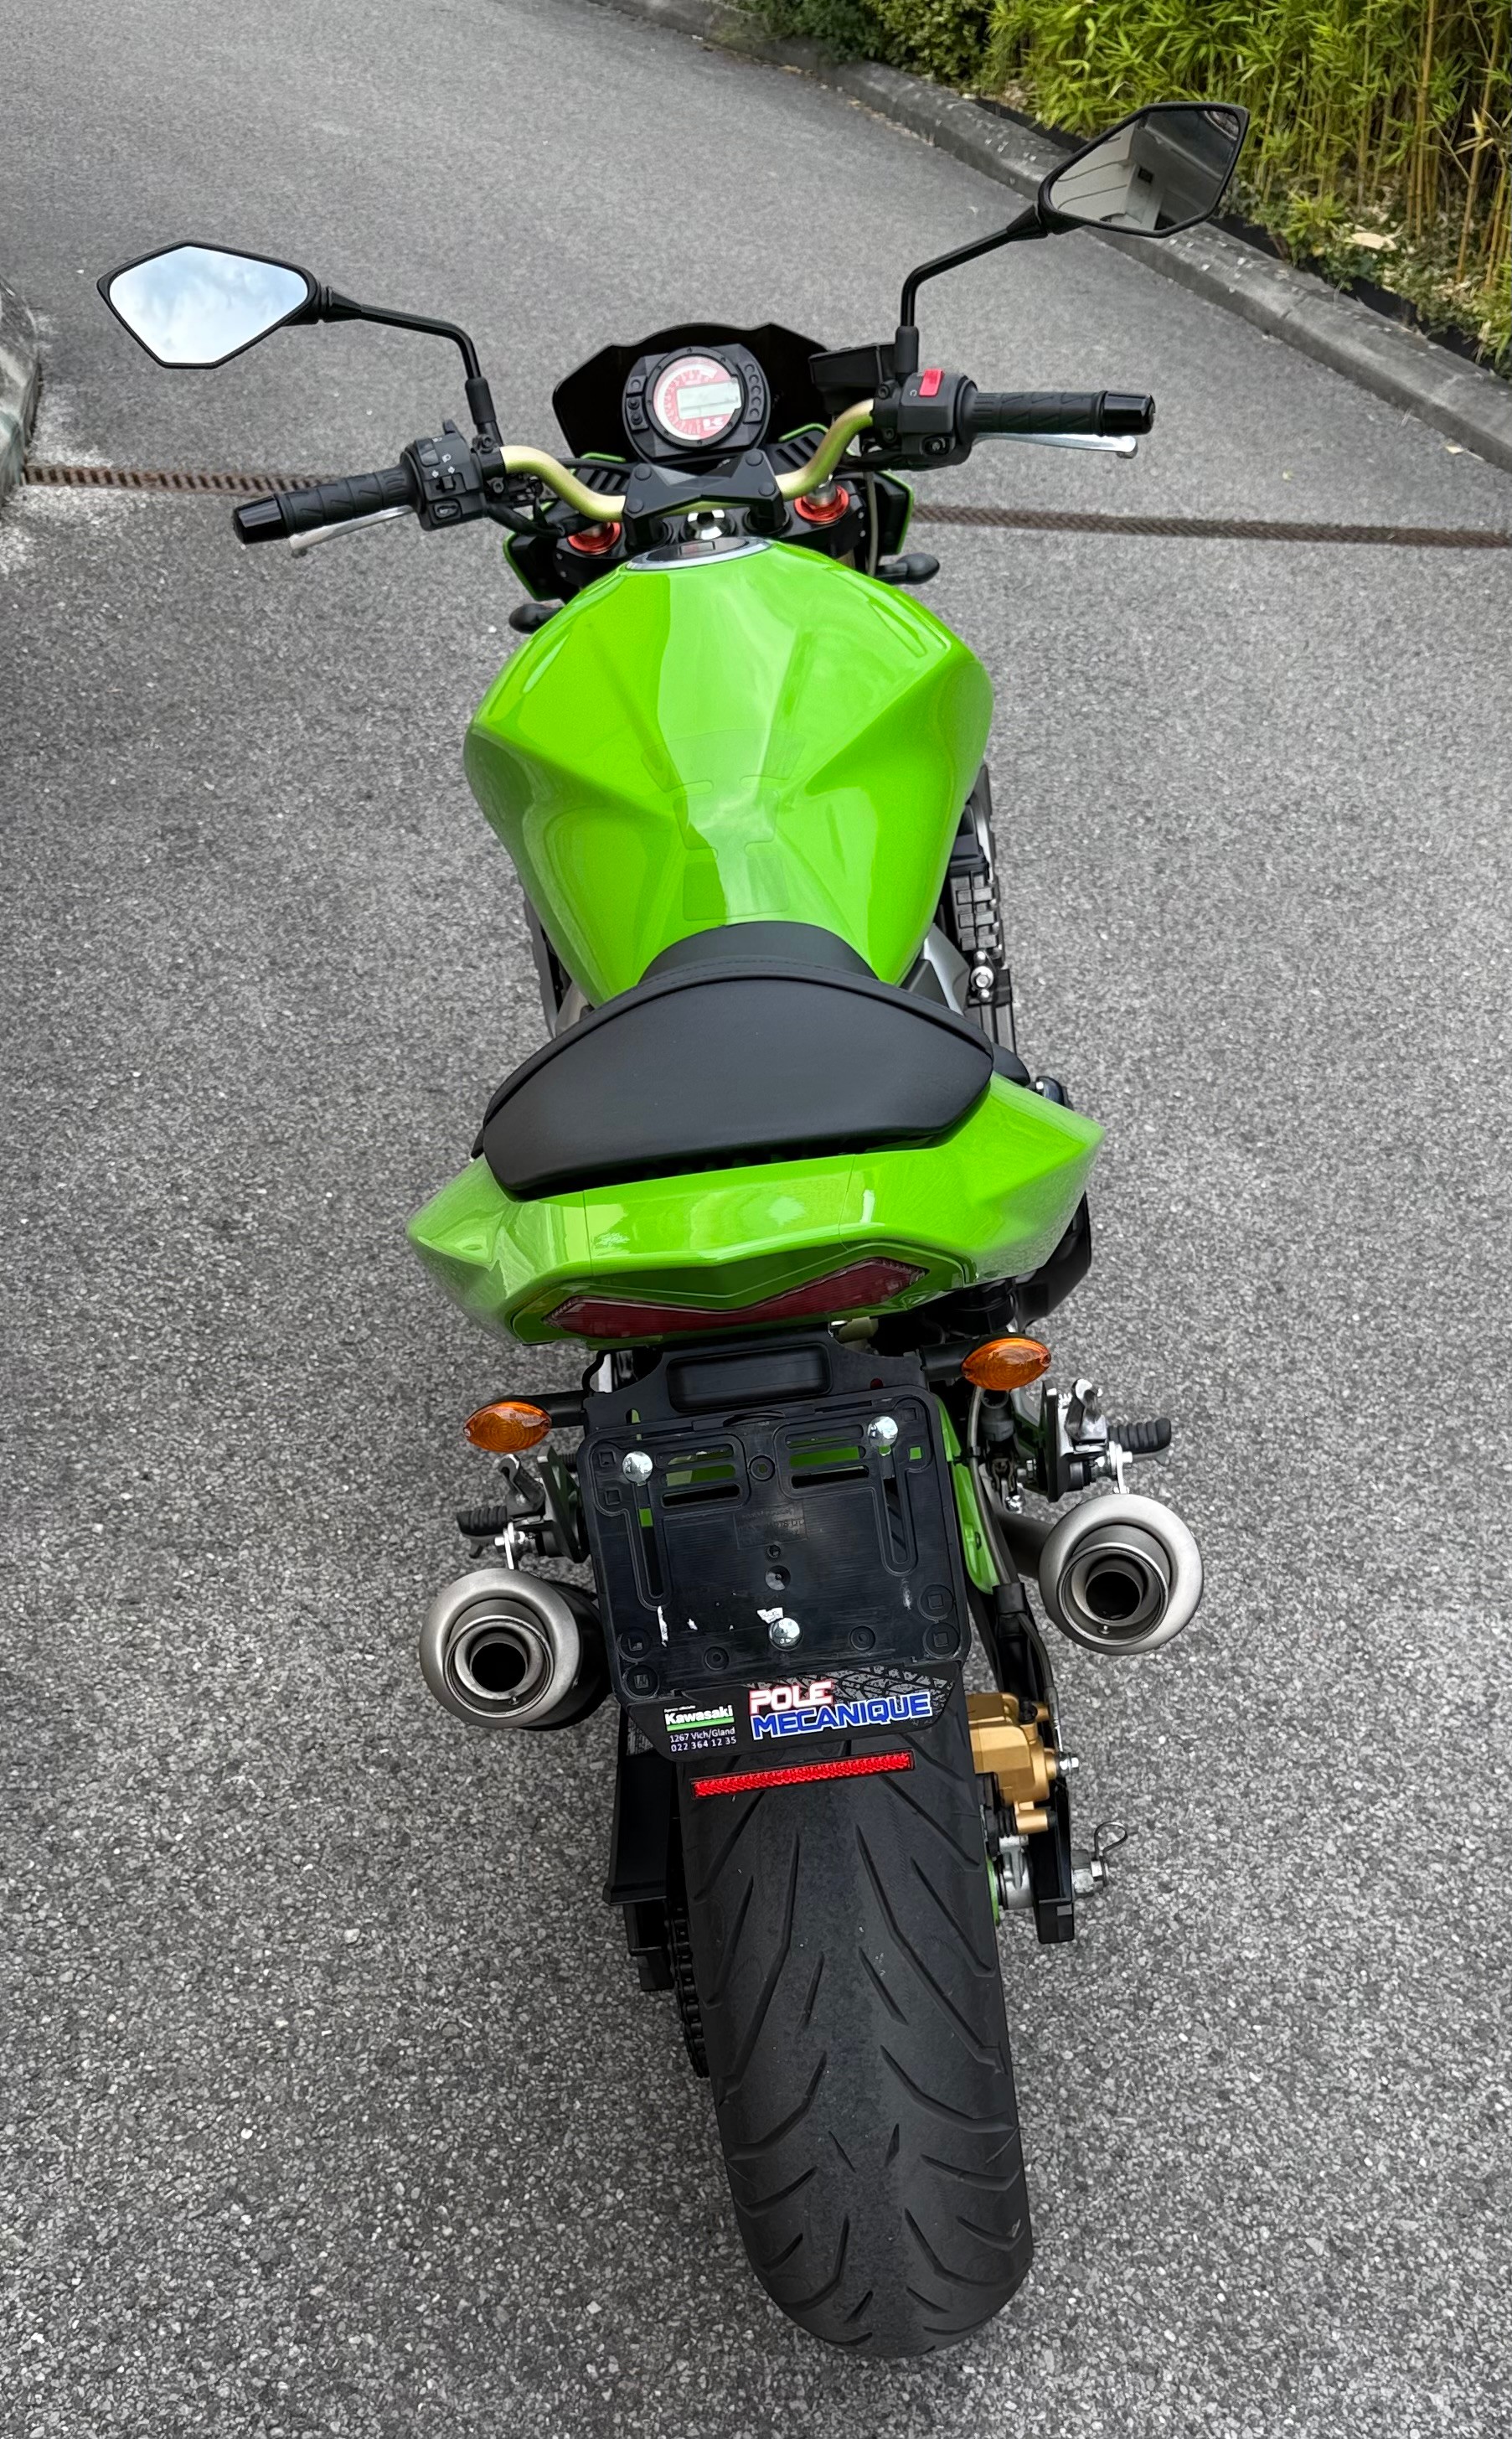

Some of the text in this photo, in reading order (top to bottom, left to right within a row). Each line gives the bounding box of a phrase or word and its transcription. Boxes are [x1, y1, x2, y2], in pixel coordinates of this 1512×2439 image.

[749, 1679, 834, 1715] POLE
[664, 1705, 734, 1726] Kawasaki
[751, 1692, 933, 1740] MECANIQUE
[670, 1726, 735, 1744] 1267 Vich/Gland
[671, 1736, 737, 1752] 022 364 12 35
